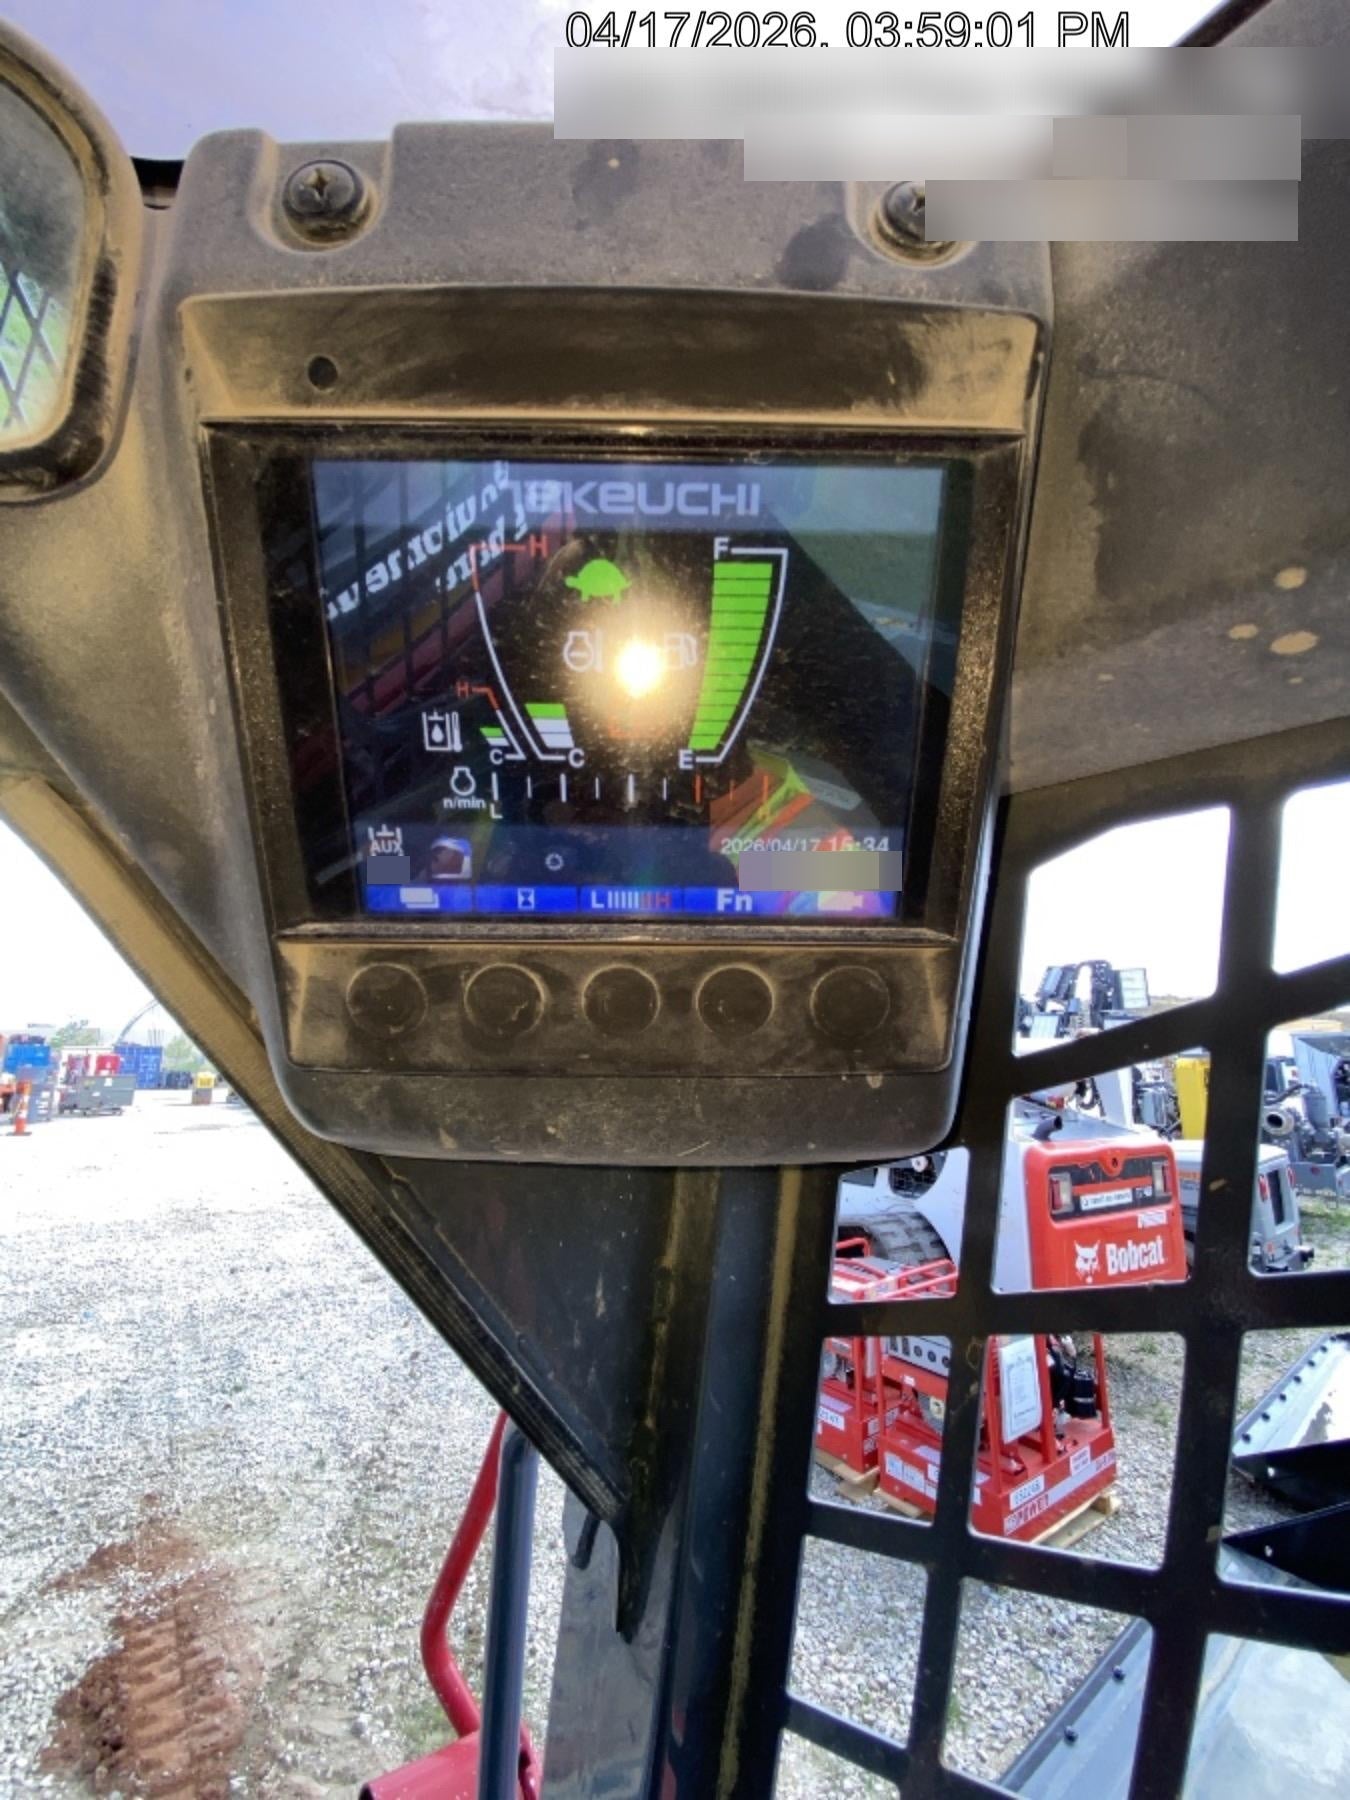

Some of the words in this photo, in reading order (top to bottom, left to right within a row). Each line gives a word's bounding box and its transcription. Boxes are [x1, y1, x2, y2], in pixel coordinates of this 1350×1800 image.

[713, 537, 729, 560] F
[489, 748, 504, 765] C
[568, 748, 585, 768] C
[678, 749, 694, 770] E
[369, 839, 403, 855] AUX
[716, 888, 753, 912] Fn
[1105, 1235, 1165, 1276] Bobcat
